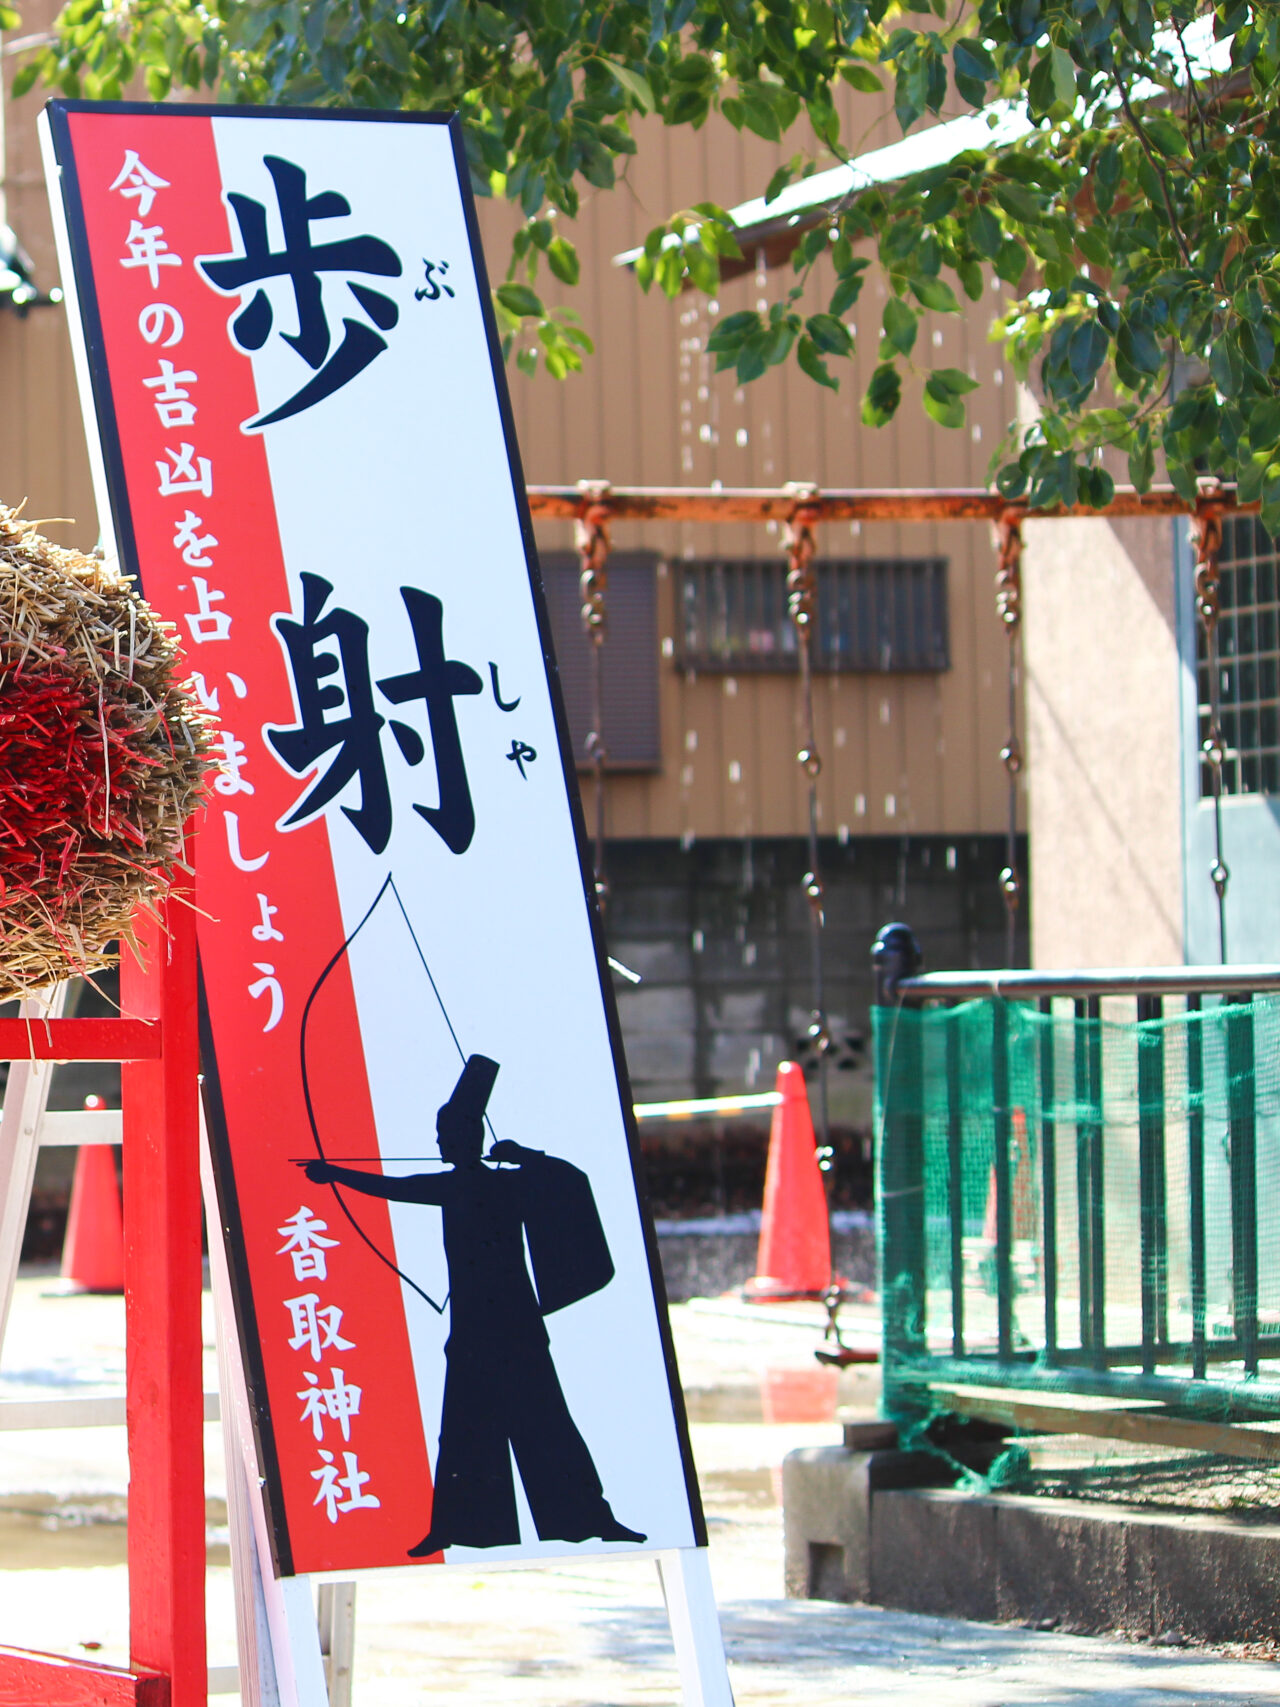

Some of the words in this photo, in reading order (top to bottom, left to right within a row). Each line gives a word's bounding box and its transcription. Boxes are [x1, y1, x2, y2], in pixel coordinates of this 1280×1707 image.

[197, 154, 485, 855] 歩射
[414, 257, 456, 302] ぶ
[108, 148, 285, 1034] 今年の吉凶を占いましょう
[275, 1205, 381, 1525] 香取神社
